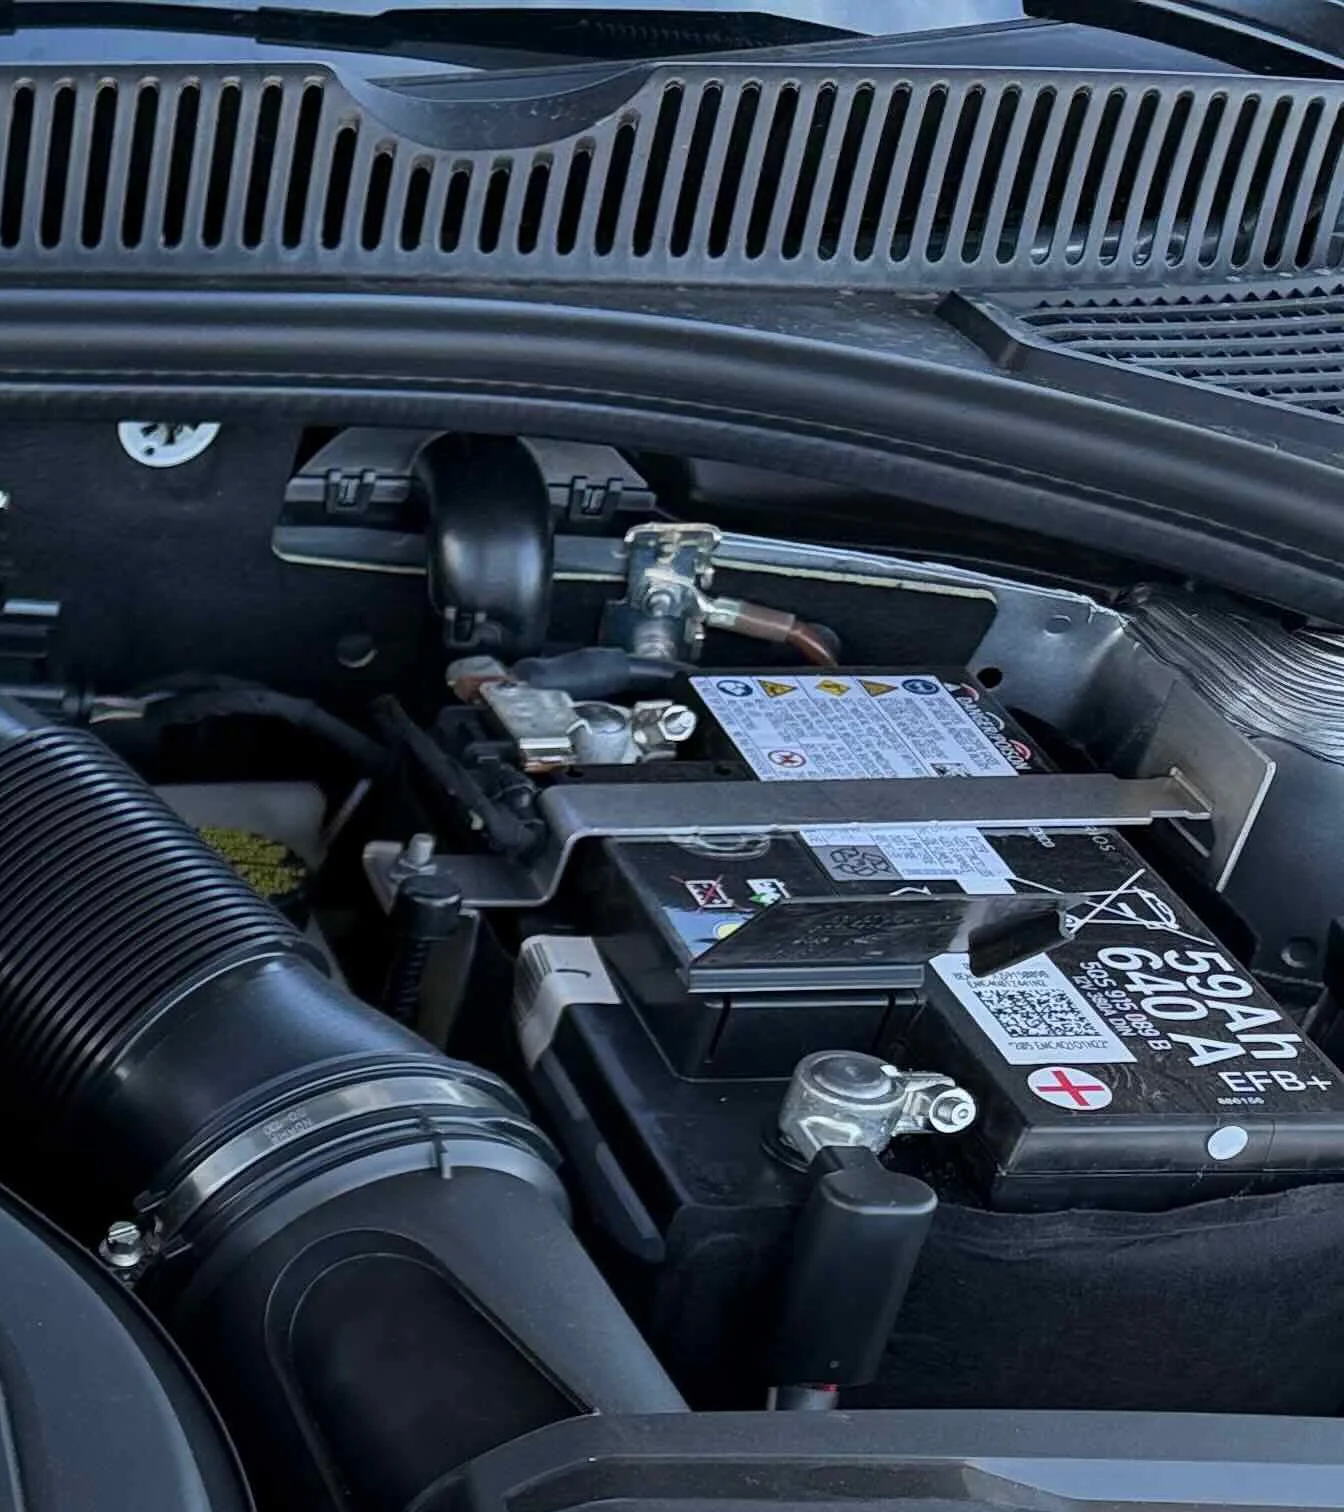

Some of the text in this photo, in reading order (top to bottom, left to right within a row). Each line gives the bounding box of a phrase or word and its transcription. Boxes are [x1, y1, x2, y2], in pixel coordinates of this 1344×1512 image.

[1079, 960, 1174, 1052] 5QS 915 089 B
[1097, 946, 1247, 1068] 640 A
[1107, 1017, 1138, 1038] DIN
[1163, 949, 1304, 1060] 59Ah
[1217, 1069, 1332, 1094] EFB+
